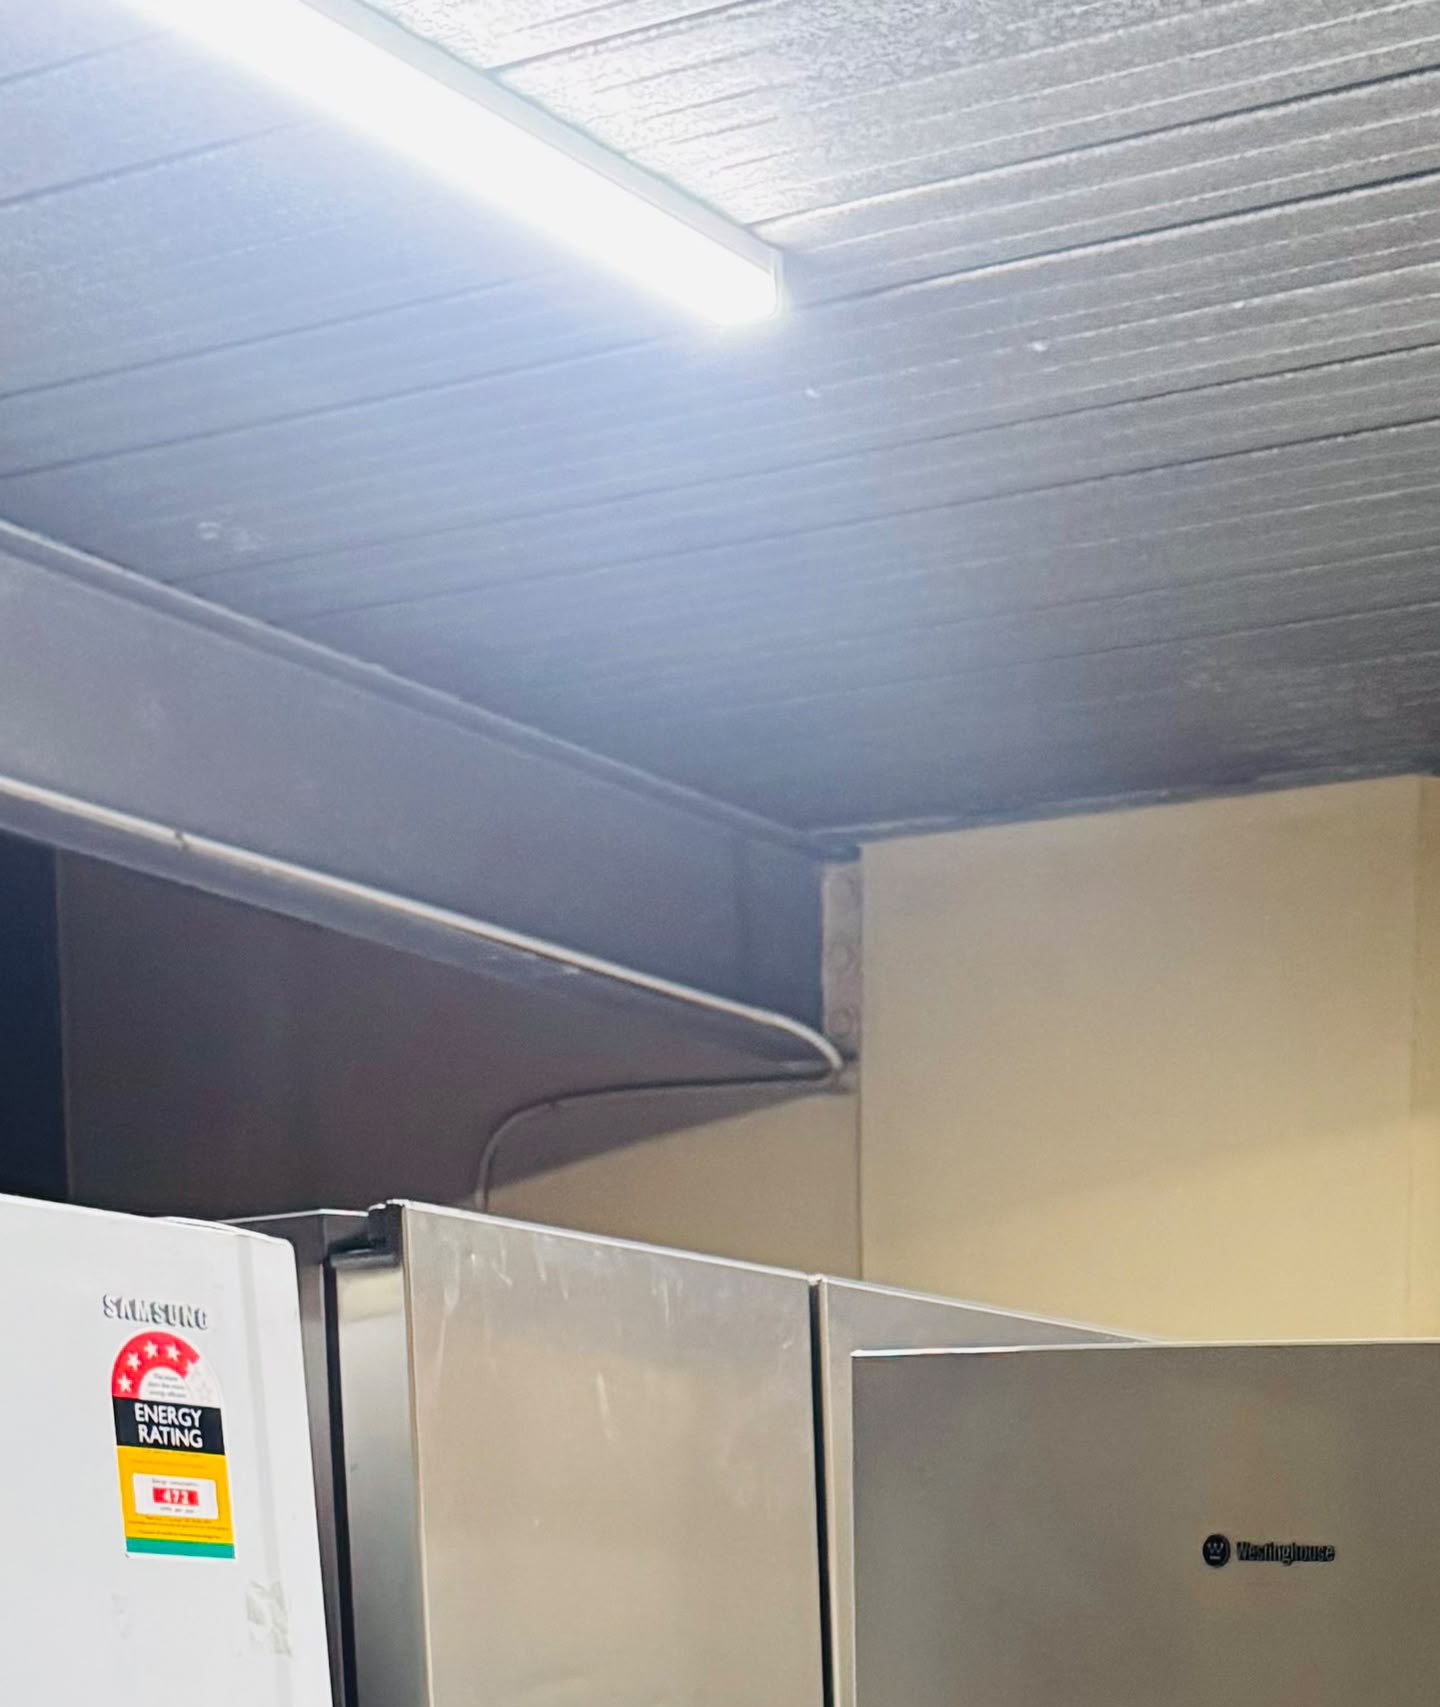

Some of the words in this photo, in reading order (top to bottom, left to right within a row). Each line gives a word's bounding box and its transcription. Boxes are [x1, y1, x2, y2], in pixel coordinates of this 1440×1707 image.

[103, 1294, 208, 1330] SAMSUNG
[134, 1402, 202, 1427] ENERGY
[138, 1424, 203, 1448] RATING
[1236, 1541, 1336, 1566] Westinghouse
